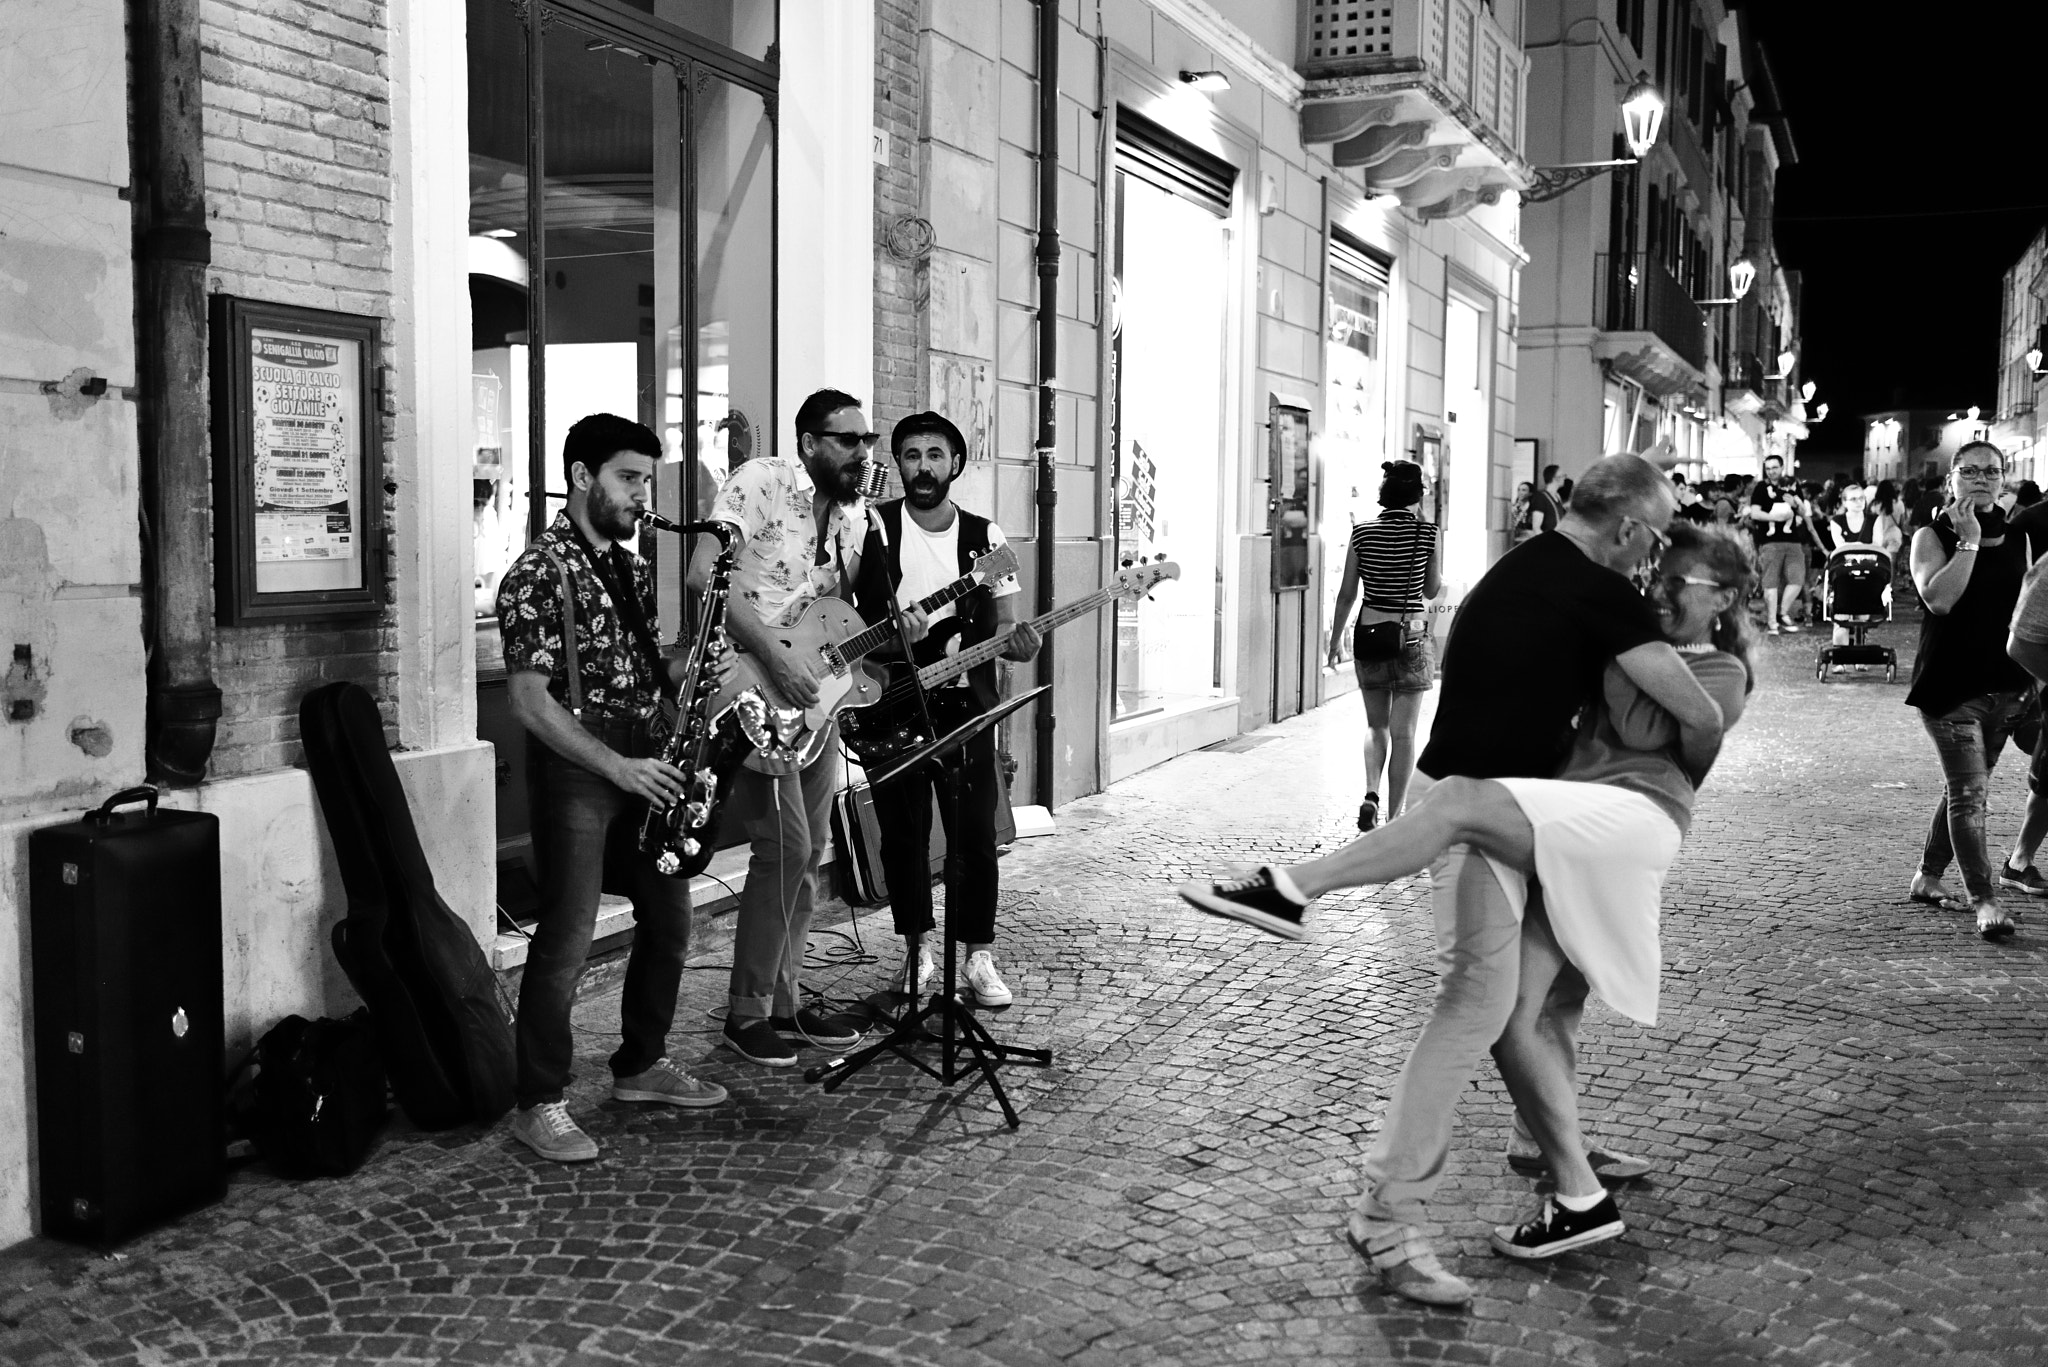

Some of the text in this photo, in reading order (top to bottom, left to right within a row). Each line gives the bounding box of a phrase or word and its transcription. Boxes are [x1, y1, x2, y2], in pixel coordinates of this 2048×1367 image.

[874, 135, 882, 155] 71
[263, 343, 325, 360] SENIGALLIA CALCIO
[254, 366, 340, 388] SCUOLA di CALCIO
[275, 384, 321, 402] SETTORE
[271, 399, 326, 417] GIOVANILE
